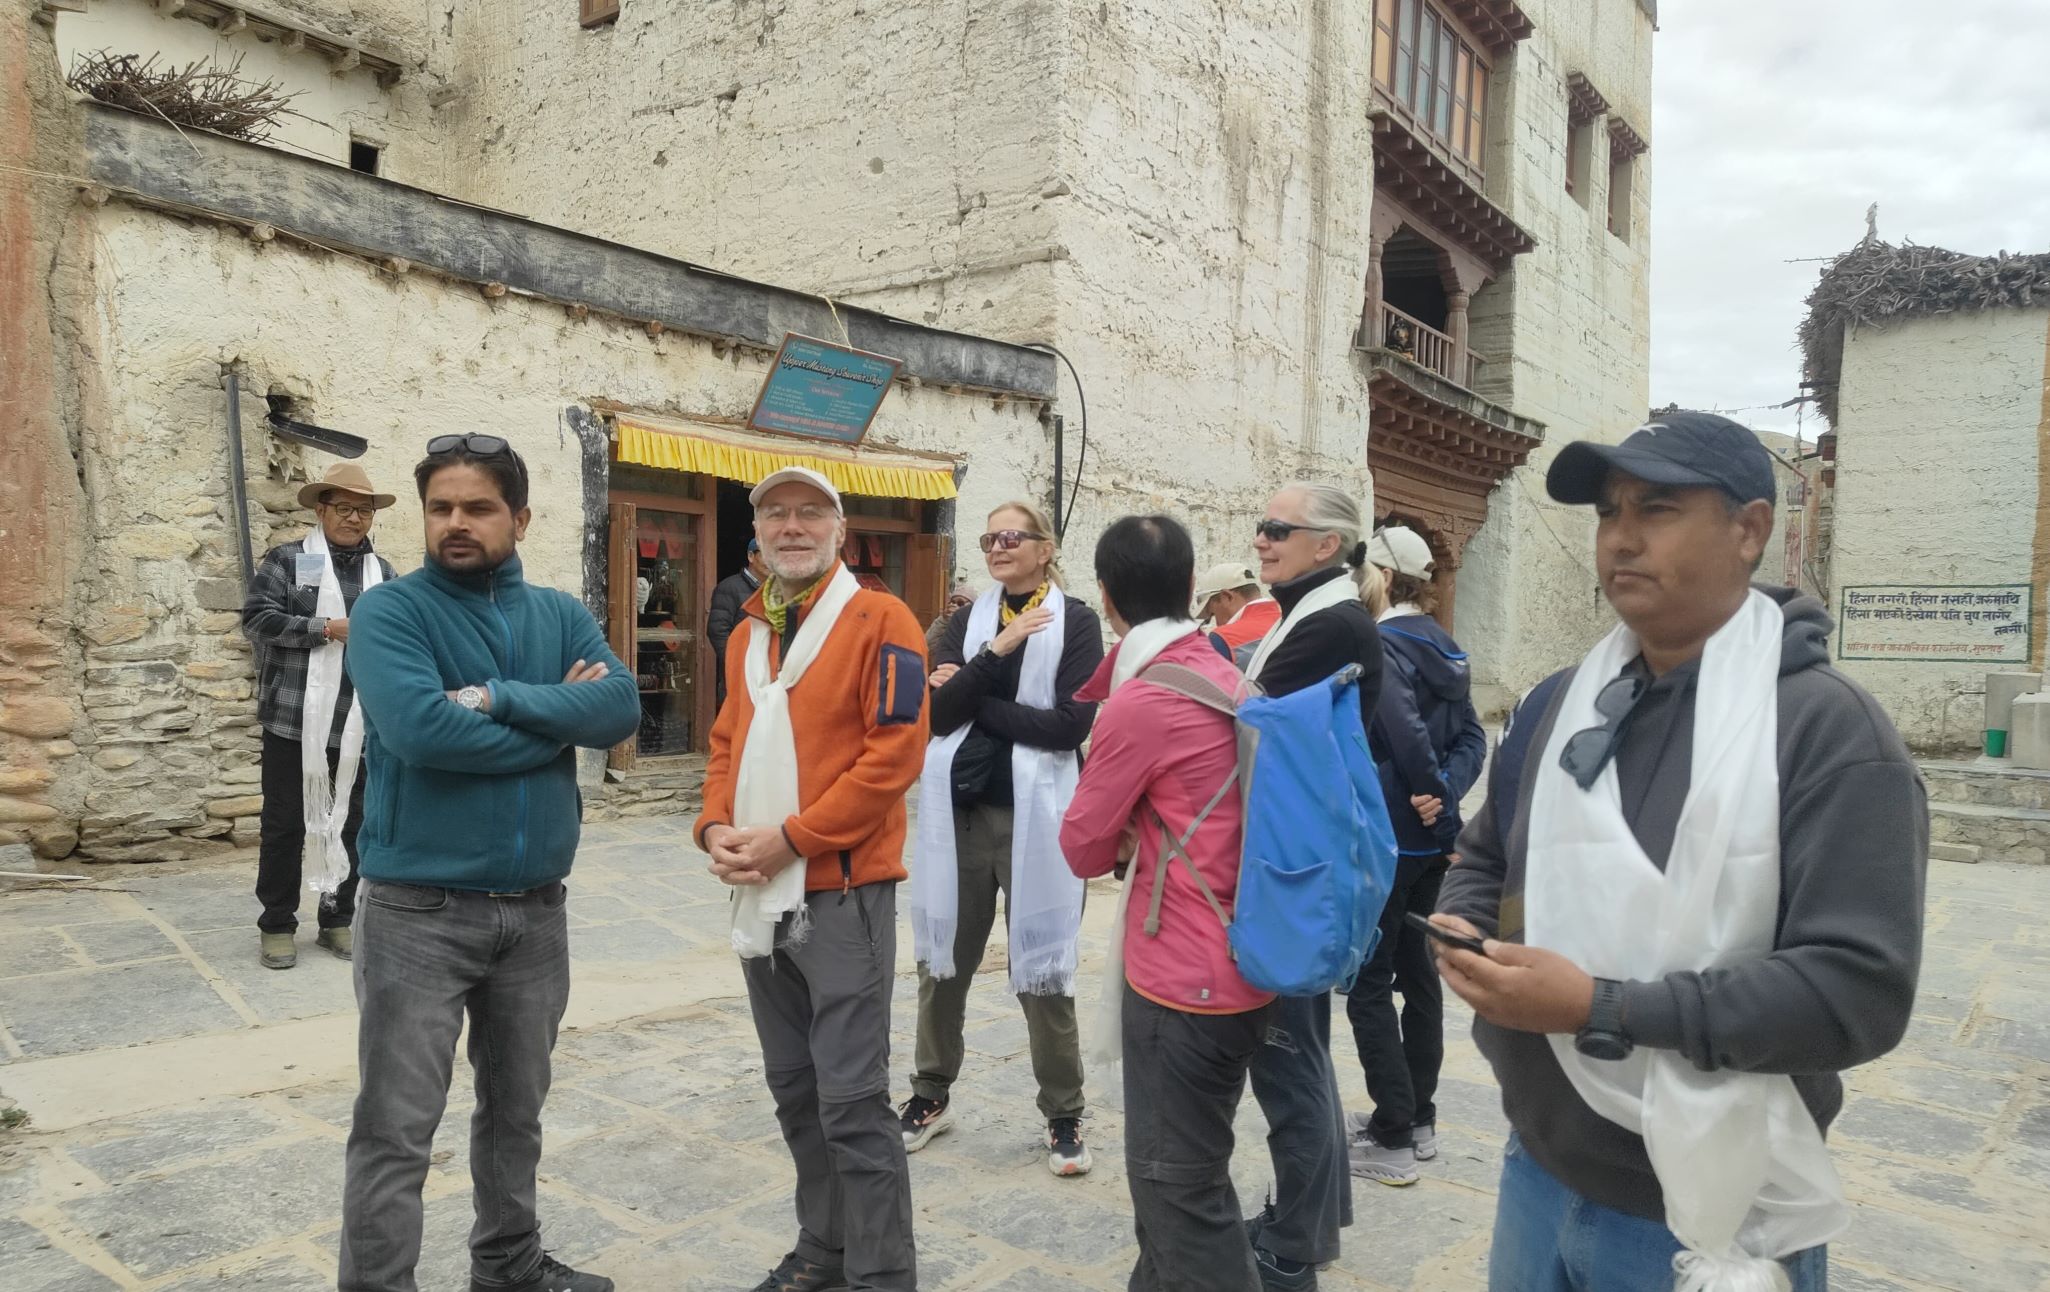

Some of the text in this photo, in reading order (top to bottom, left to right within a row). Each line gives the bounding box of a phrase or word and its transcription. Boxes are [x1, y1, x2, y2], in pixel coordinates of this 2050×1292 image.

[781, 352, 806, 370] Upper
[805, 360, 837, 379] Mustang
[865, 373, 884, 389] Shop
